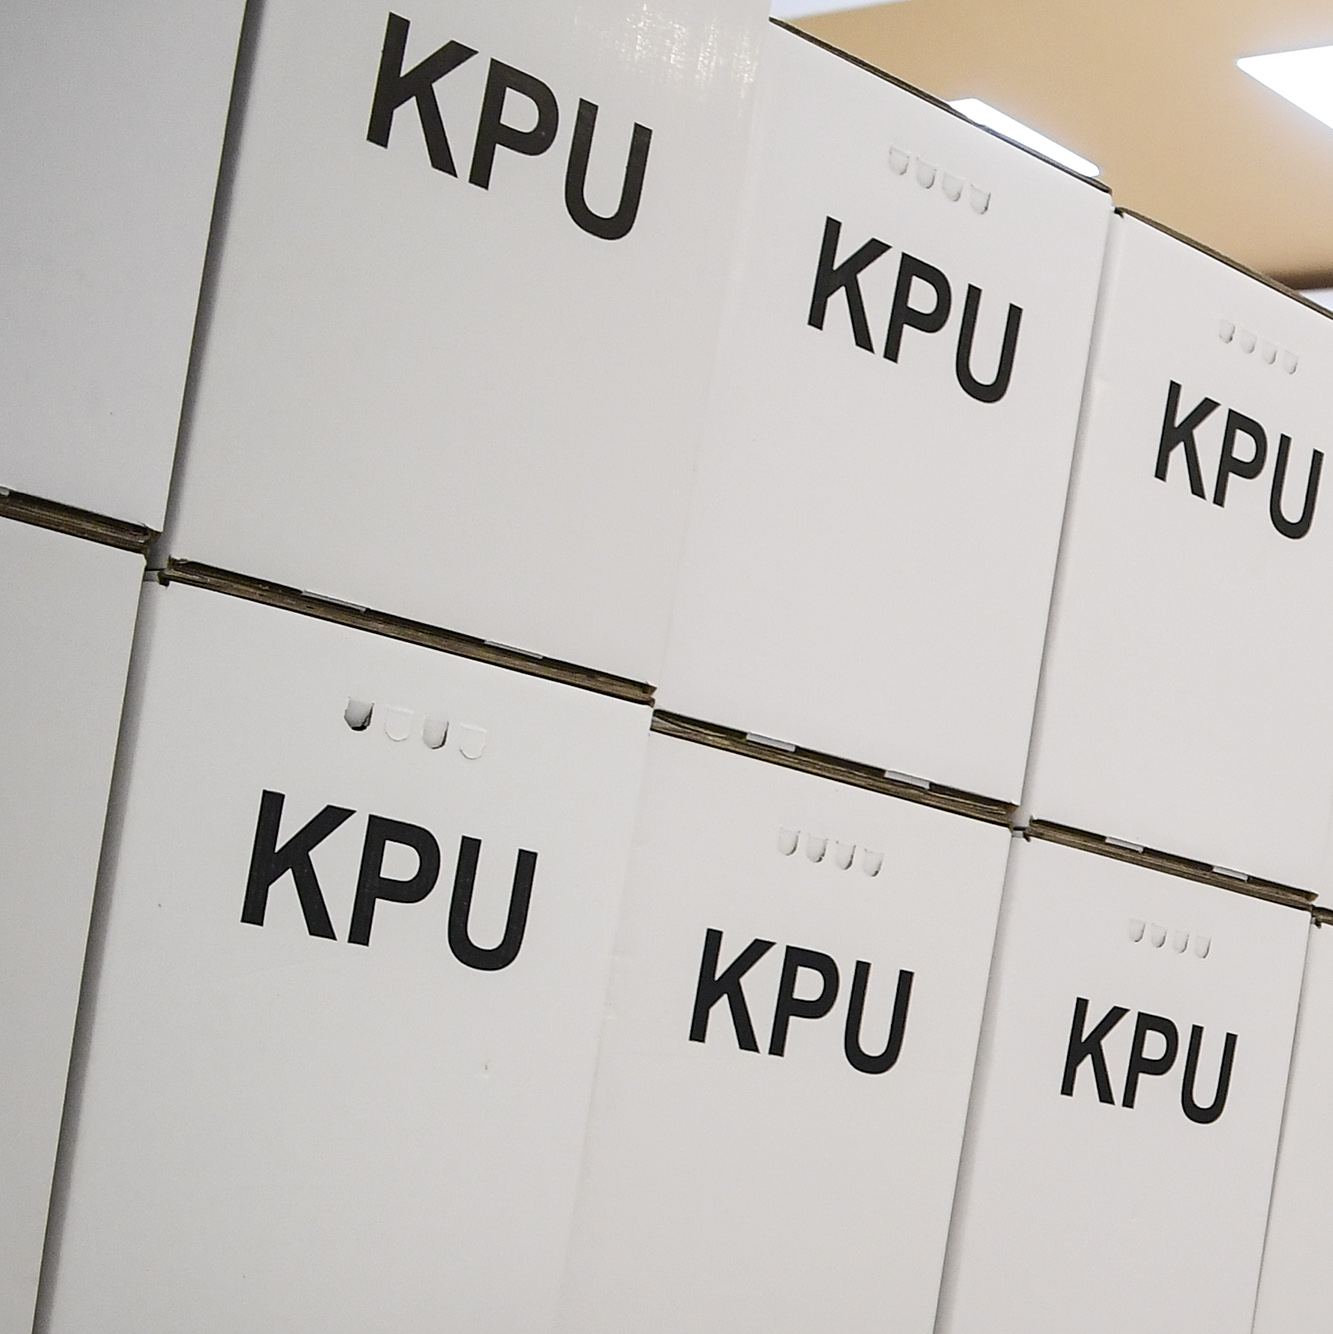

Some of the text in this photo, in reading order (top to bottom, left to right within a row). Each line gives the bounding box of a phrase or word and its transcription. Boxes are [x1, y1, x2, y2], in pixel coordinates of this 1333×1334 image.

[365, 11, 653, 241] KPU
[807, 215, 1024, 404] KPU
[1154, 379, 1325, 540] KPU
[239, 788, 539, 972] KPU
[688, 927, 915, 1075] KPU
[1060, 996, 1239, 1125] KPU
